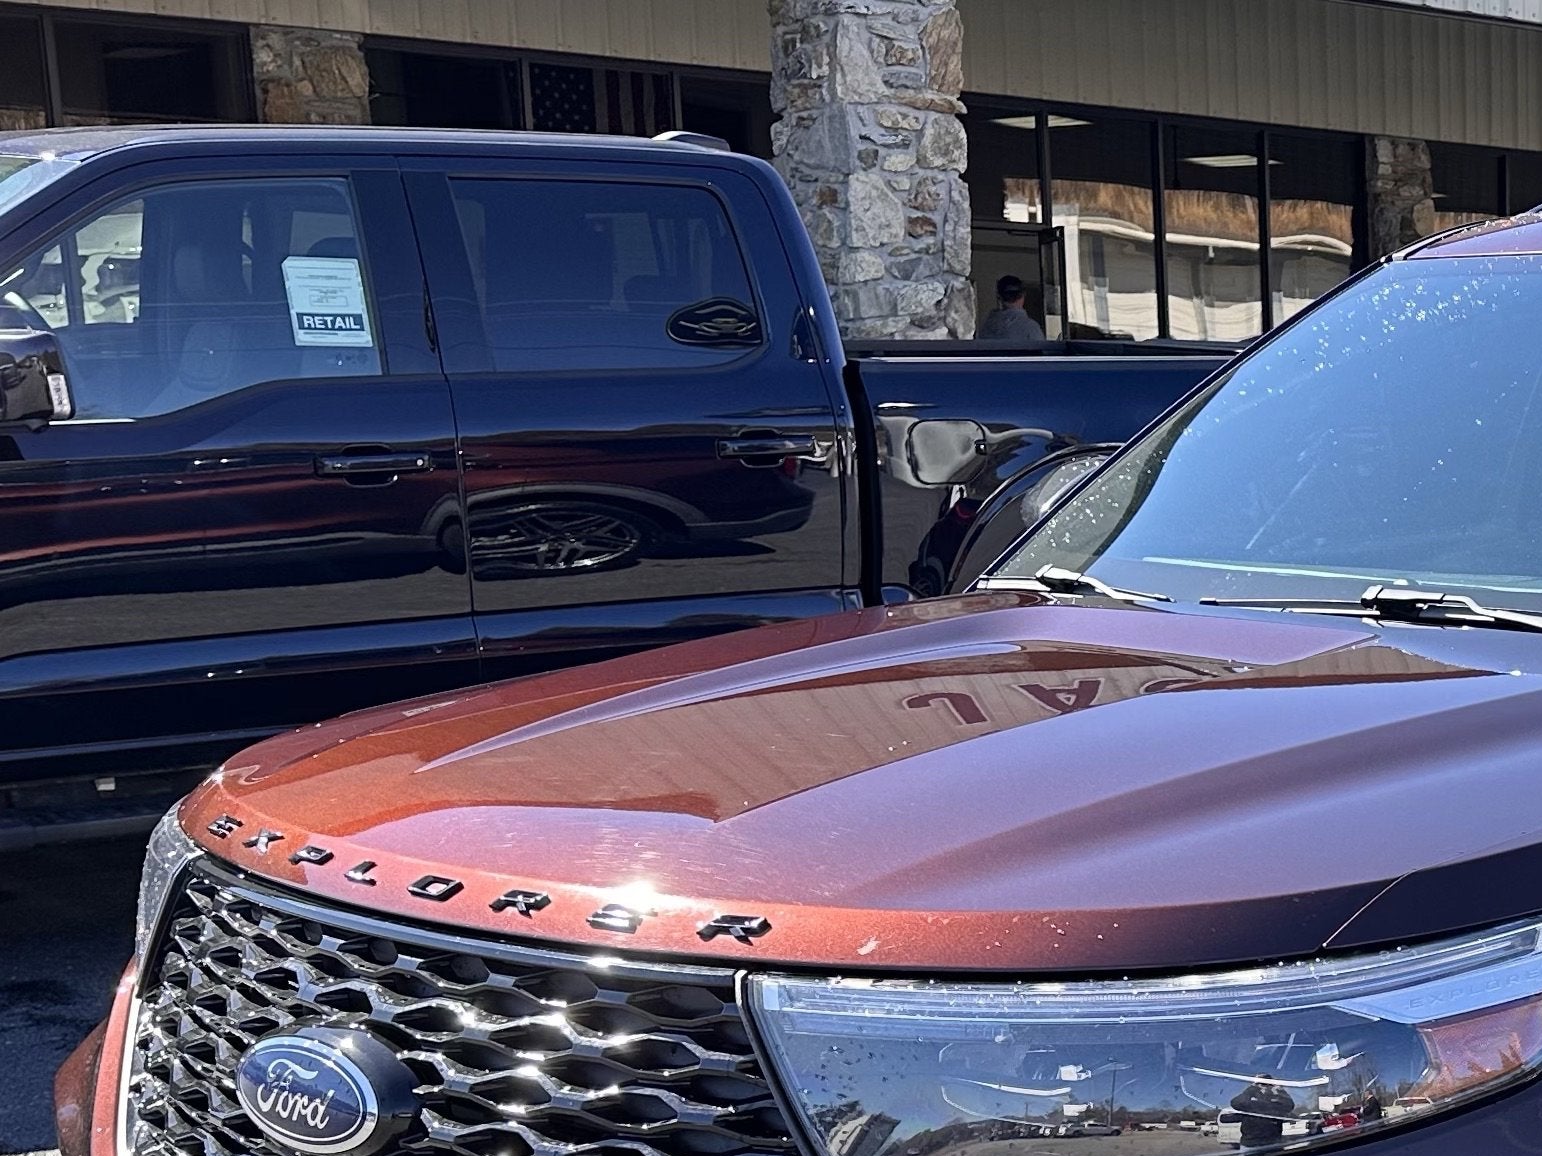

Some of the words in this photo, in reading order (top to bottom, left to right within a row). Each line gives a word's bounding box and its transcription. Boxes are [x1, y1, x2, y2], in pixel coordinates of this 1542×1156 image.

[302, 315, 361, 330] RETAIL
[207, 813, 772, 946] EXPLORER
[257, 1058, 336, 1130] Ford
